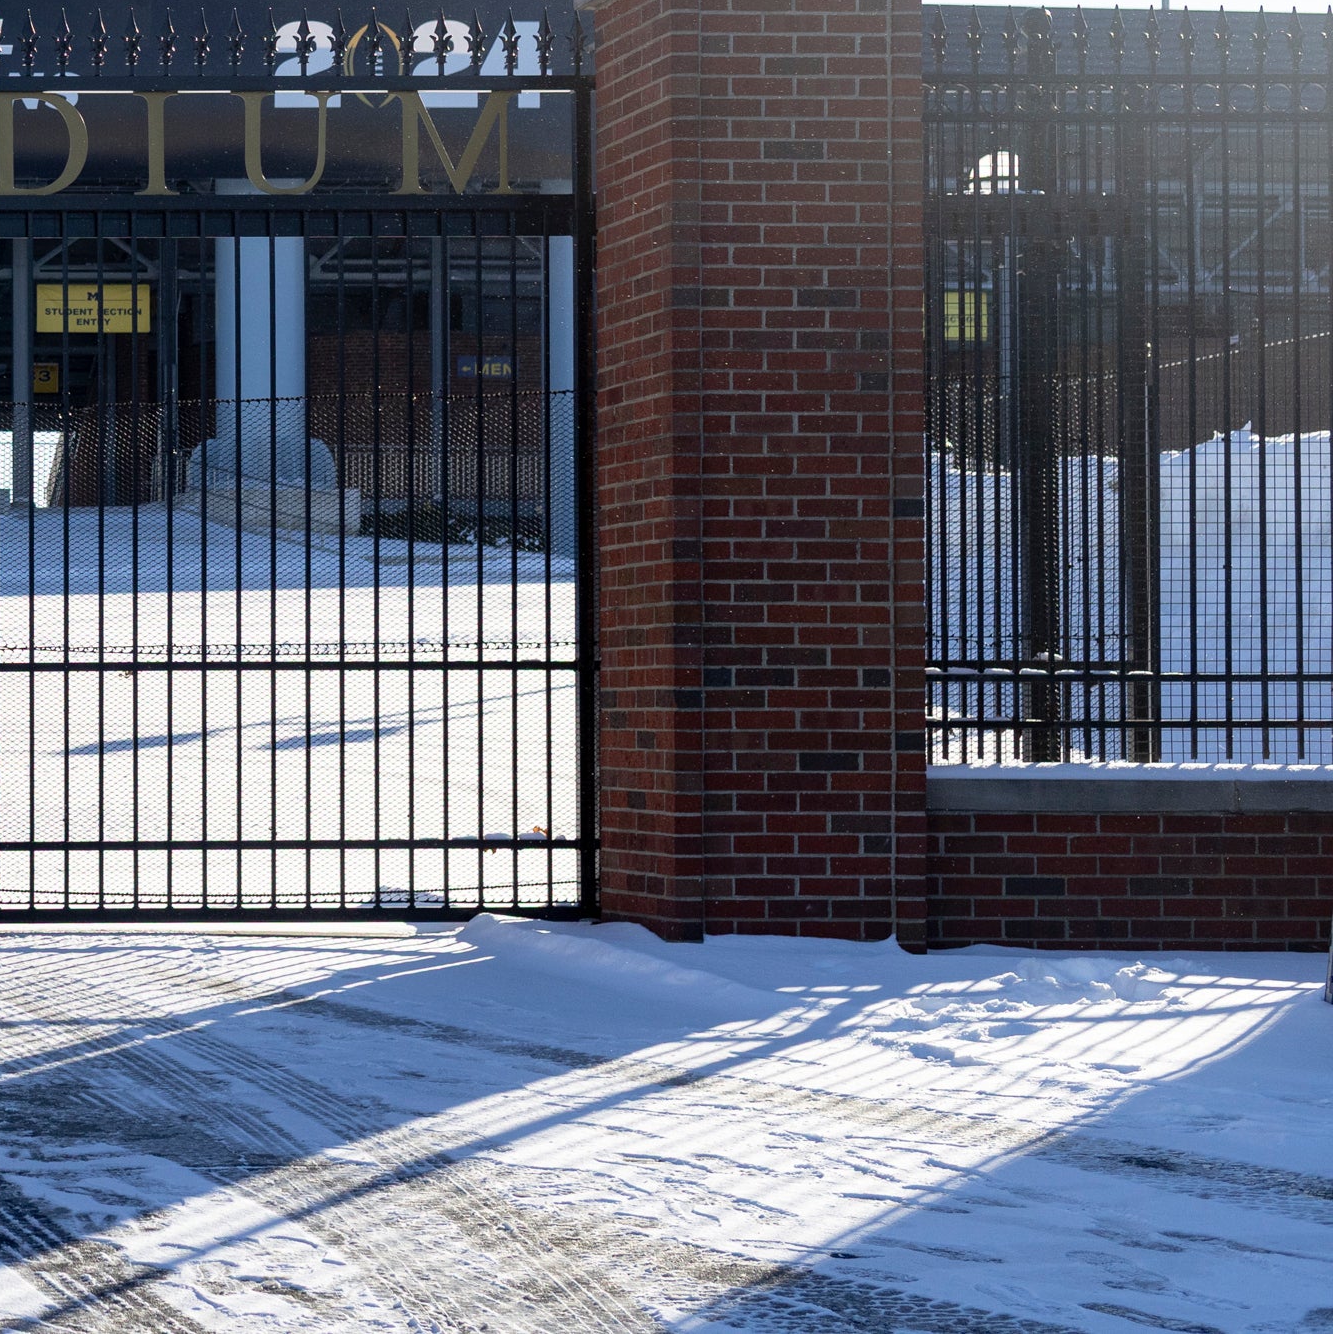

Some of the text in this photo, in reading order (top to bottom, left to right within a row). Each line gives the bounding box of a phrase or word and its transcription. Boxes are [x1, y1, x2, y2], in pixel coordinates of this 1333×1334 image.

[44, 307, 142, 316] STUDENT ECTION
[76, 318, 111, 326] ENTY
